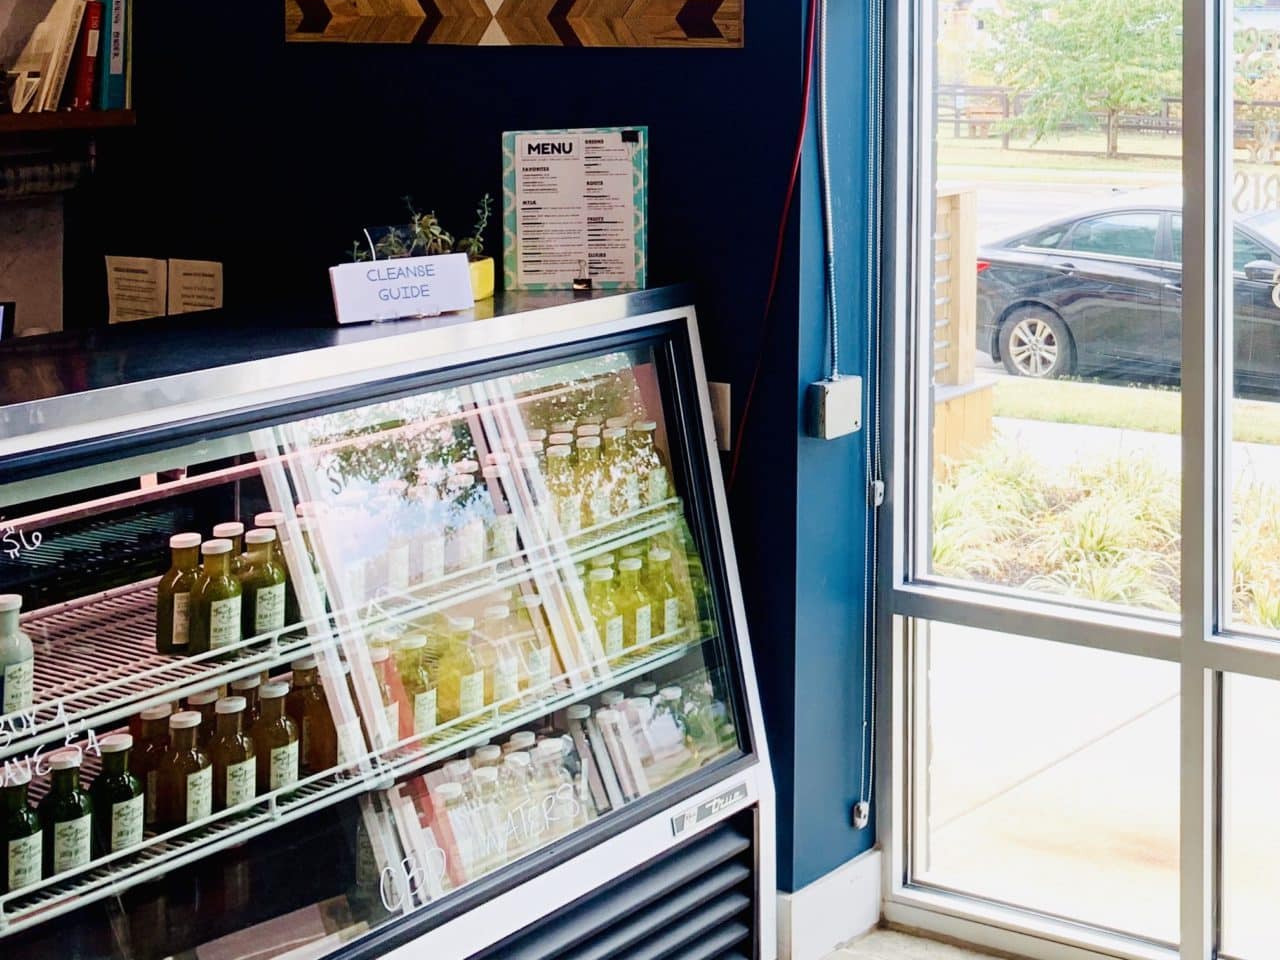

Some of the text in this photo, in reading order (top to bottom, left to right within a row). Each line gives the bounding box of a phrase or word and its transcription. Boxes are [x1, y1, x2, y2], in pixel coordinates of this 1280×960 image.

[527, 141, 573, 156] MENU
[367, 263, 436, 283] CLEANSE
[378, 284, 431, 303] GUIDE
[0, 744, 53, 788] AVE
[380, 783, 580, 913] CBD WATERS
